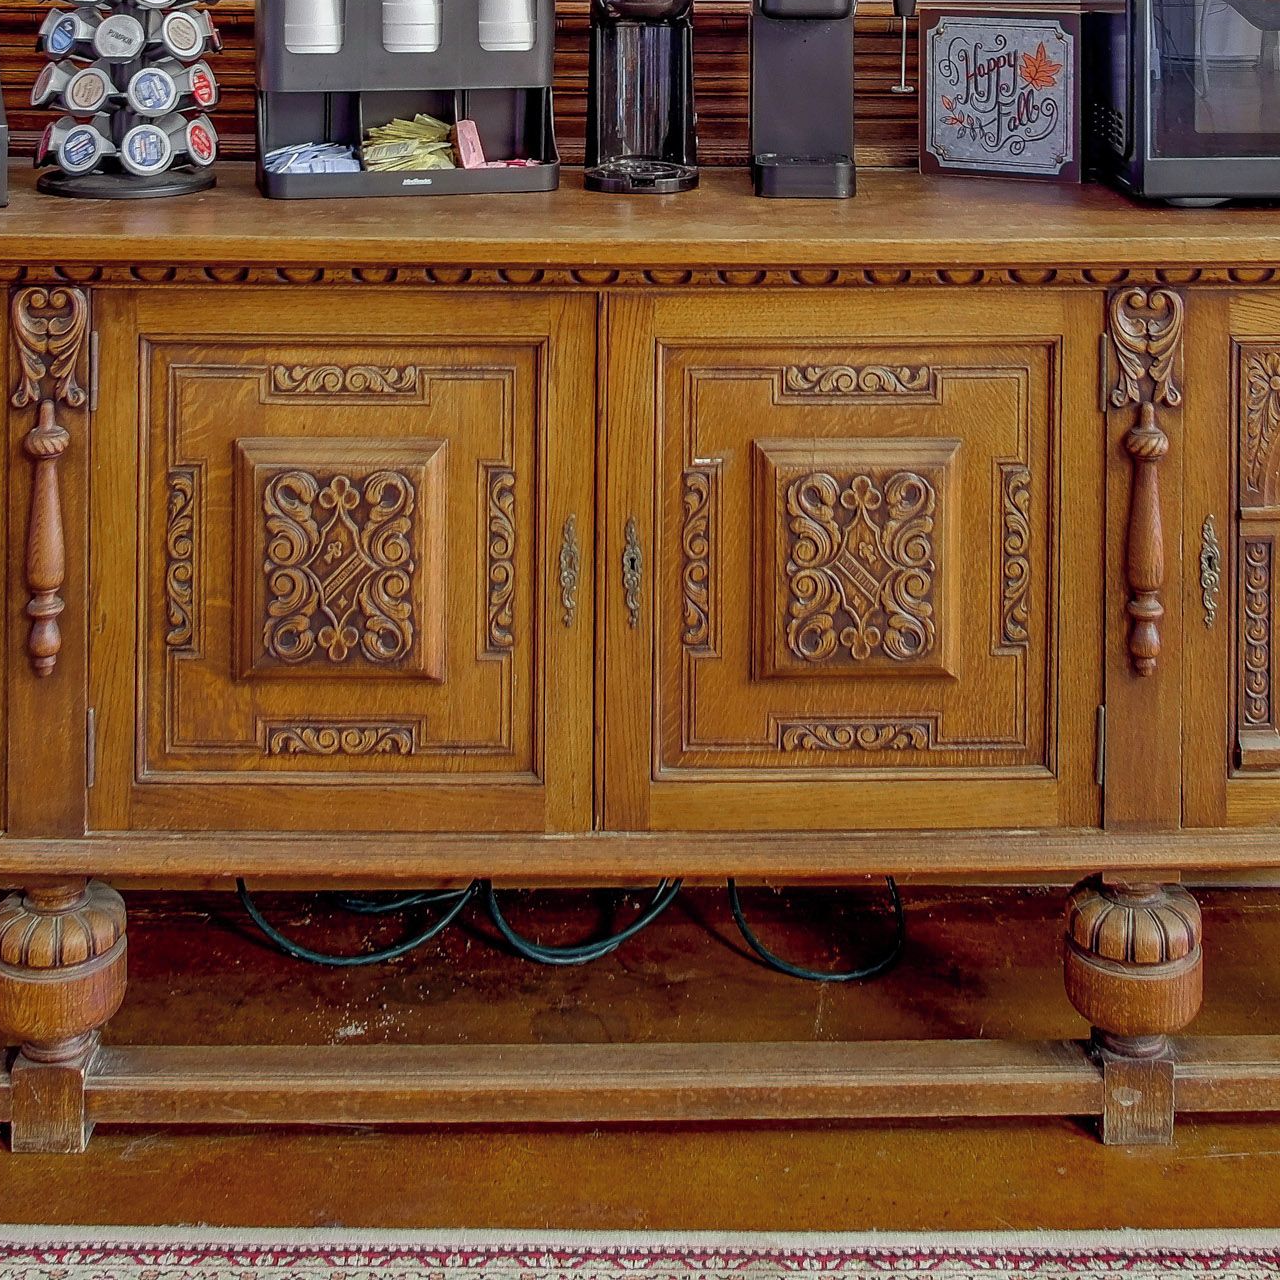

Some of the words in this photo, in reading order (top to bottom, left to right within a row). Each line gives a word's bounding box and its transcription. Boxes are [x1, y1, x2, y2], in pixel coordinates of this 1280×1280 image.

[107, 29, 134, 46] PUMPKIN
[956, 35, 1019, 113] Happy
[984, 88, 1042, 149] Fall
